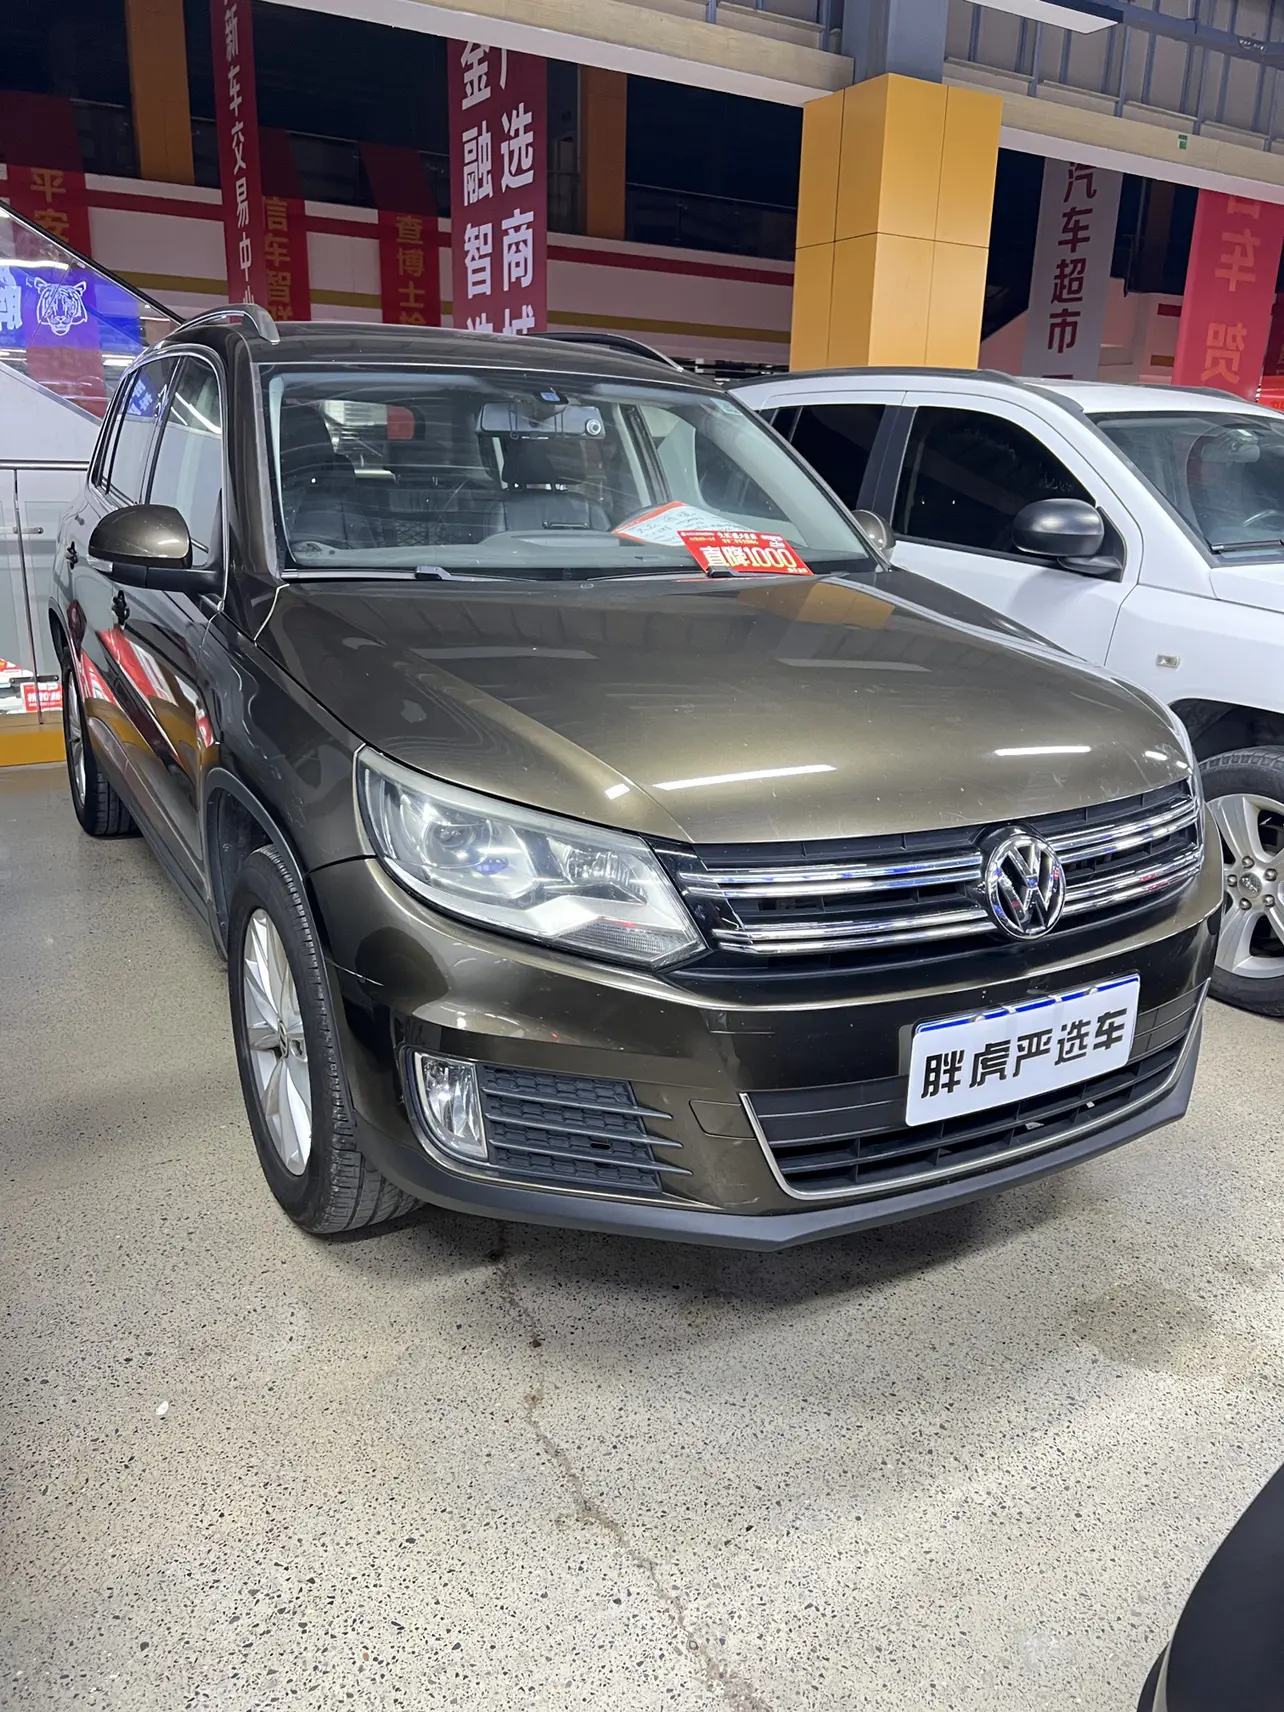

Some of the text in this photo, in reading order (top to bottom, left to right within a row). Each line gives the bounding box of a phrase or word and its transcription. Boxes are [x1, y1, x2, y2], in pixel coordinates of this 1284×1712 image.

[224, 3, 255, 303] 新车交易中
[500, 48, 535, 335] 选商
[1042, 161, 1097, 380] 汽车超市
[700, 545, 797, 568] 直降1000
[921, 1008, 1128, 1098] 胖虎严选车
